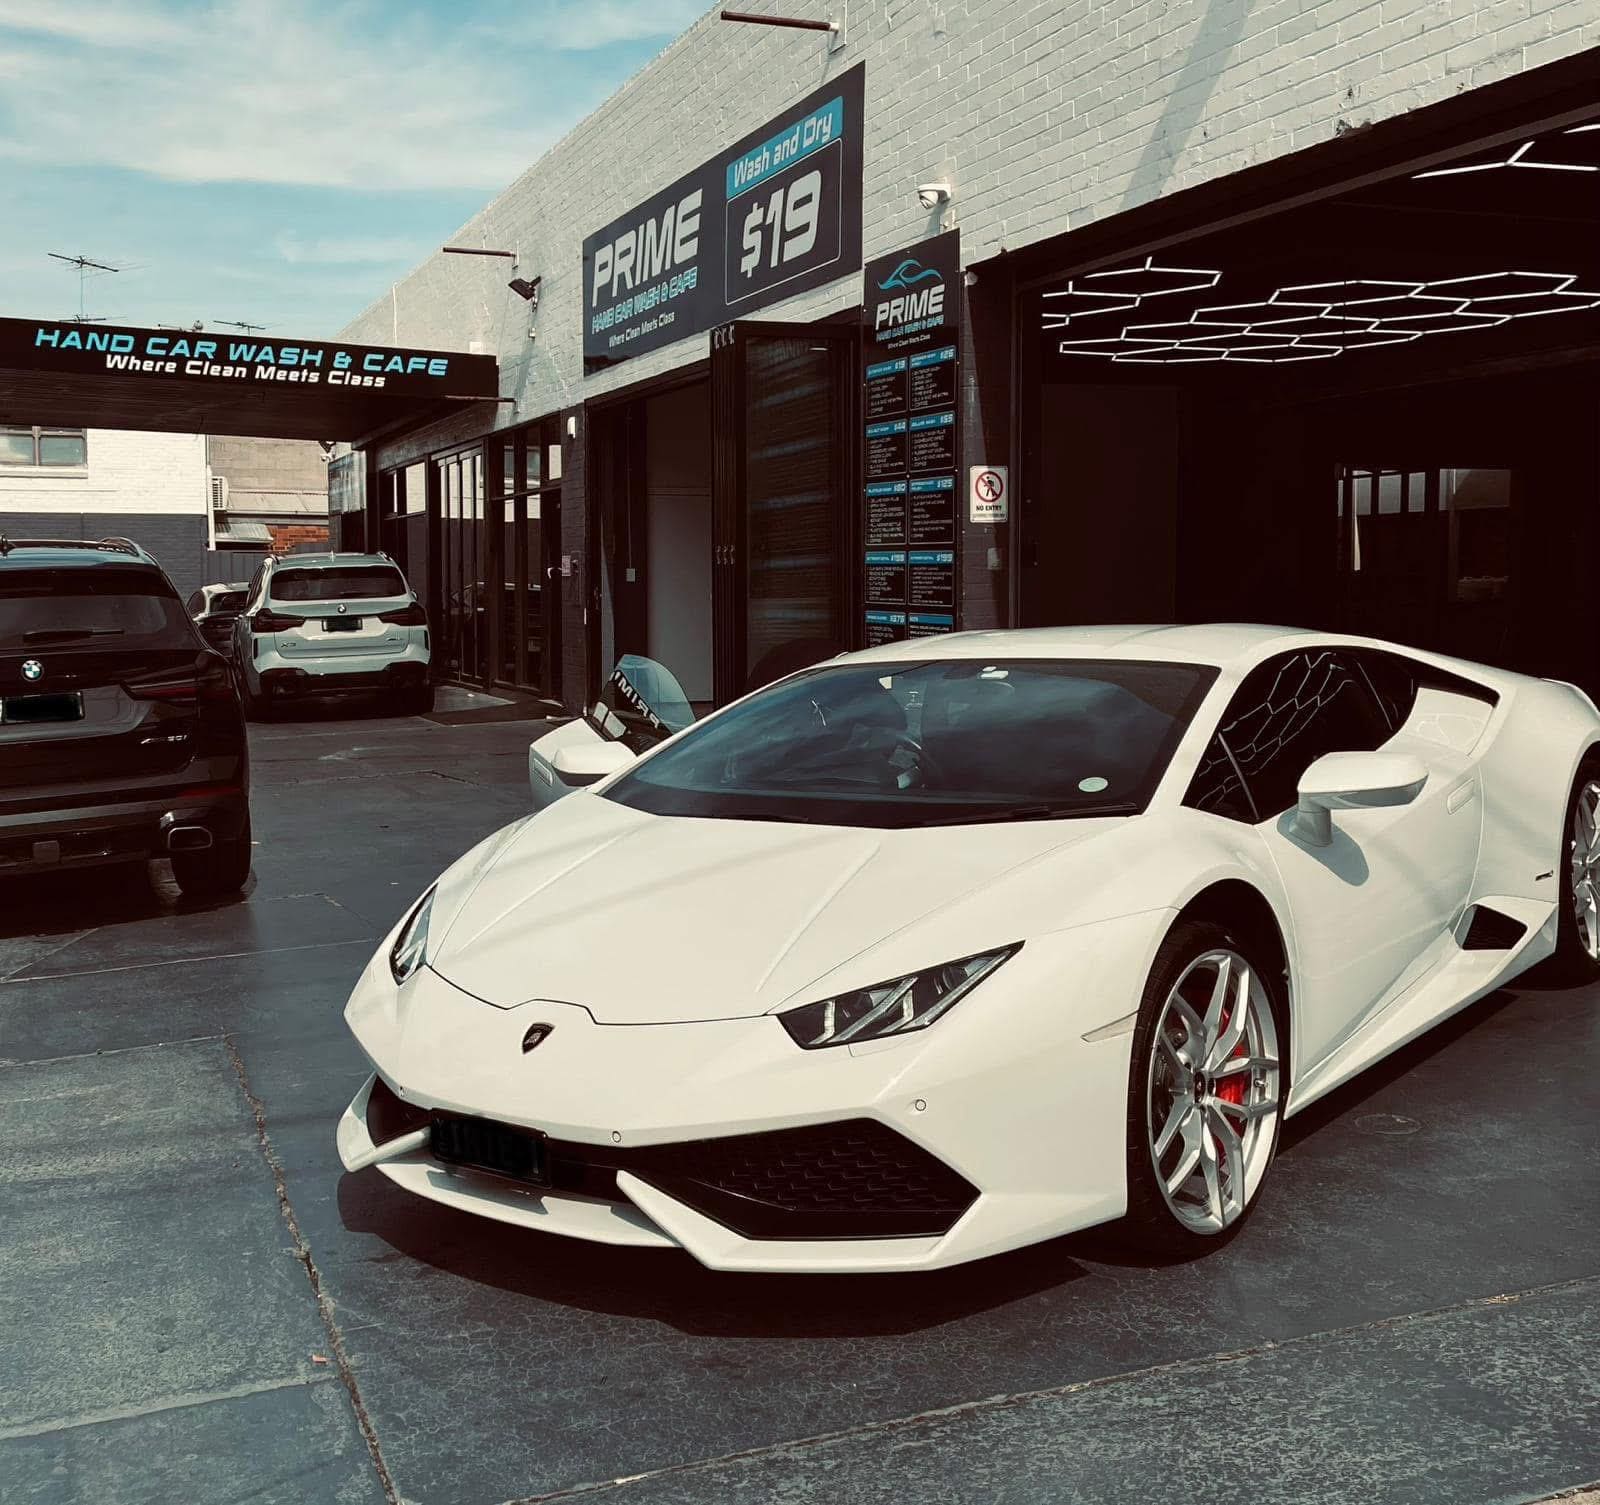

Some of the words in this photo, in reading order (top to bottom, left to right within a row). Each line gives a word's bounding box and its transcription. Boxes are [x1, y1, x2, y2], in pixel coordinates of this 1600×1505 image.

[734, 147, 770, 188] Wash
[772, 126, 800, 160] and
[802, 113, 833, 147] Dry
[592, 188, 703, 307] PRIME
[740, 169, 822, 278] $19
[625, 327, 641, 341] Clean
[641, 318, 658, 336] Meets
[658, 311, 675, 328] Class
[875, 284, 945, 331] PRIME
[34, 328, 135, 353] HAND
[145, 337, 217, 360] CAR
[228, 343, 323, 367] WASH
[332, 351, 352, 369] &
[362, 353, 449, 377] CAFE
[105, 353, 178, 374] Where
[184, 360, 247, 379] Clean
[254, 365, 320, 383] Meets
[327, 370, 386, 388] Class
[985, 504, 1003, 512] ENTRY
